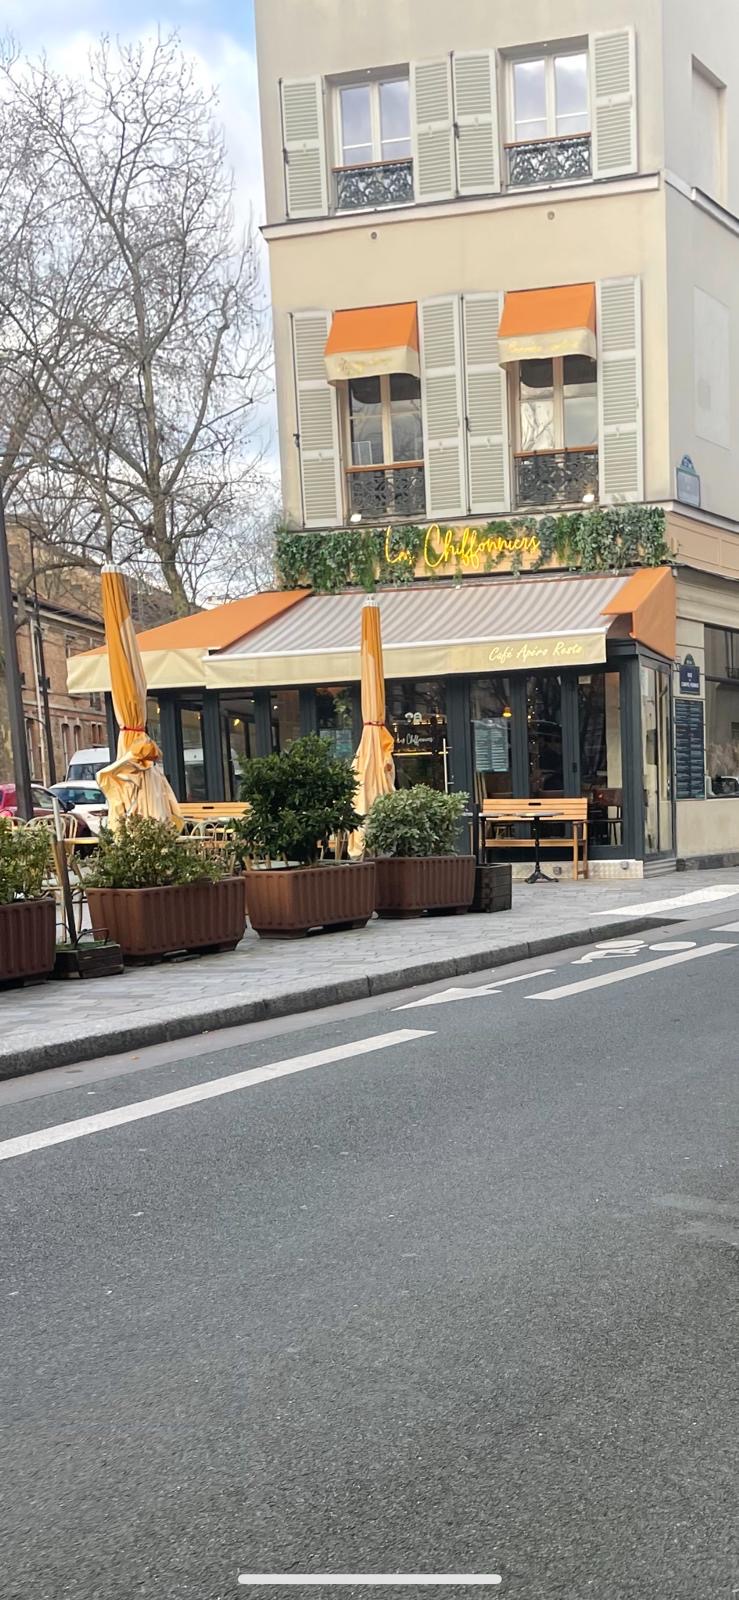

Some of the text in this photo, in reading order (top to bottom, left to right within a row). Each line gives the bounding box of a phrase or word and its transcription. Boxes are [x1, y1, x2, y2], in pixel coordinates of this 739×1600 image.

[424, 523, 541, 569] Chiffonniers
[488, 641, 584, 664] Café Apéro Resto
